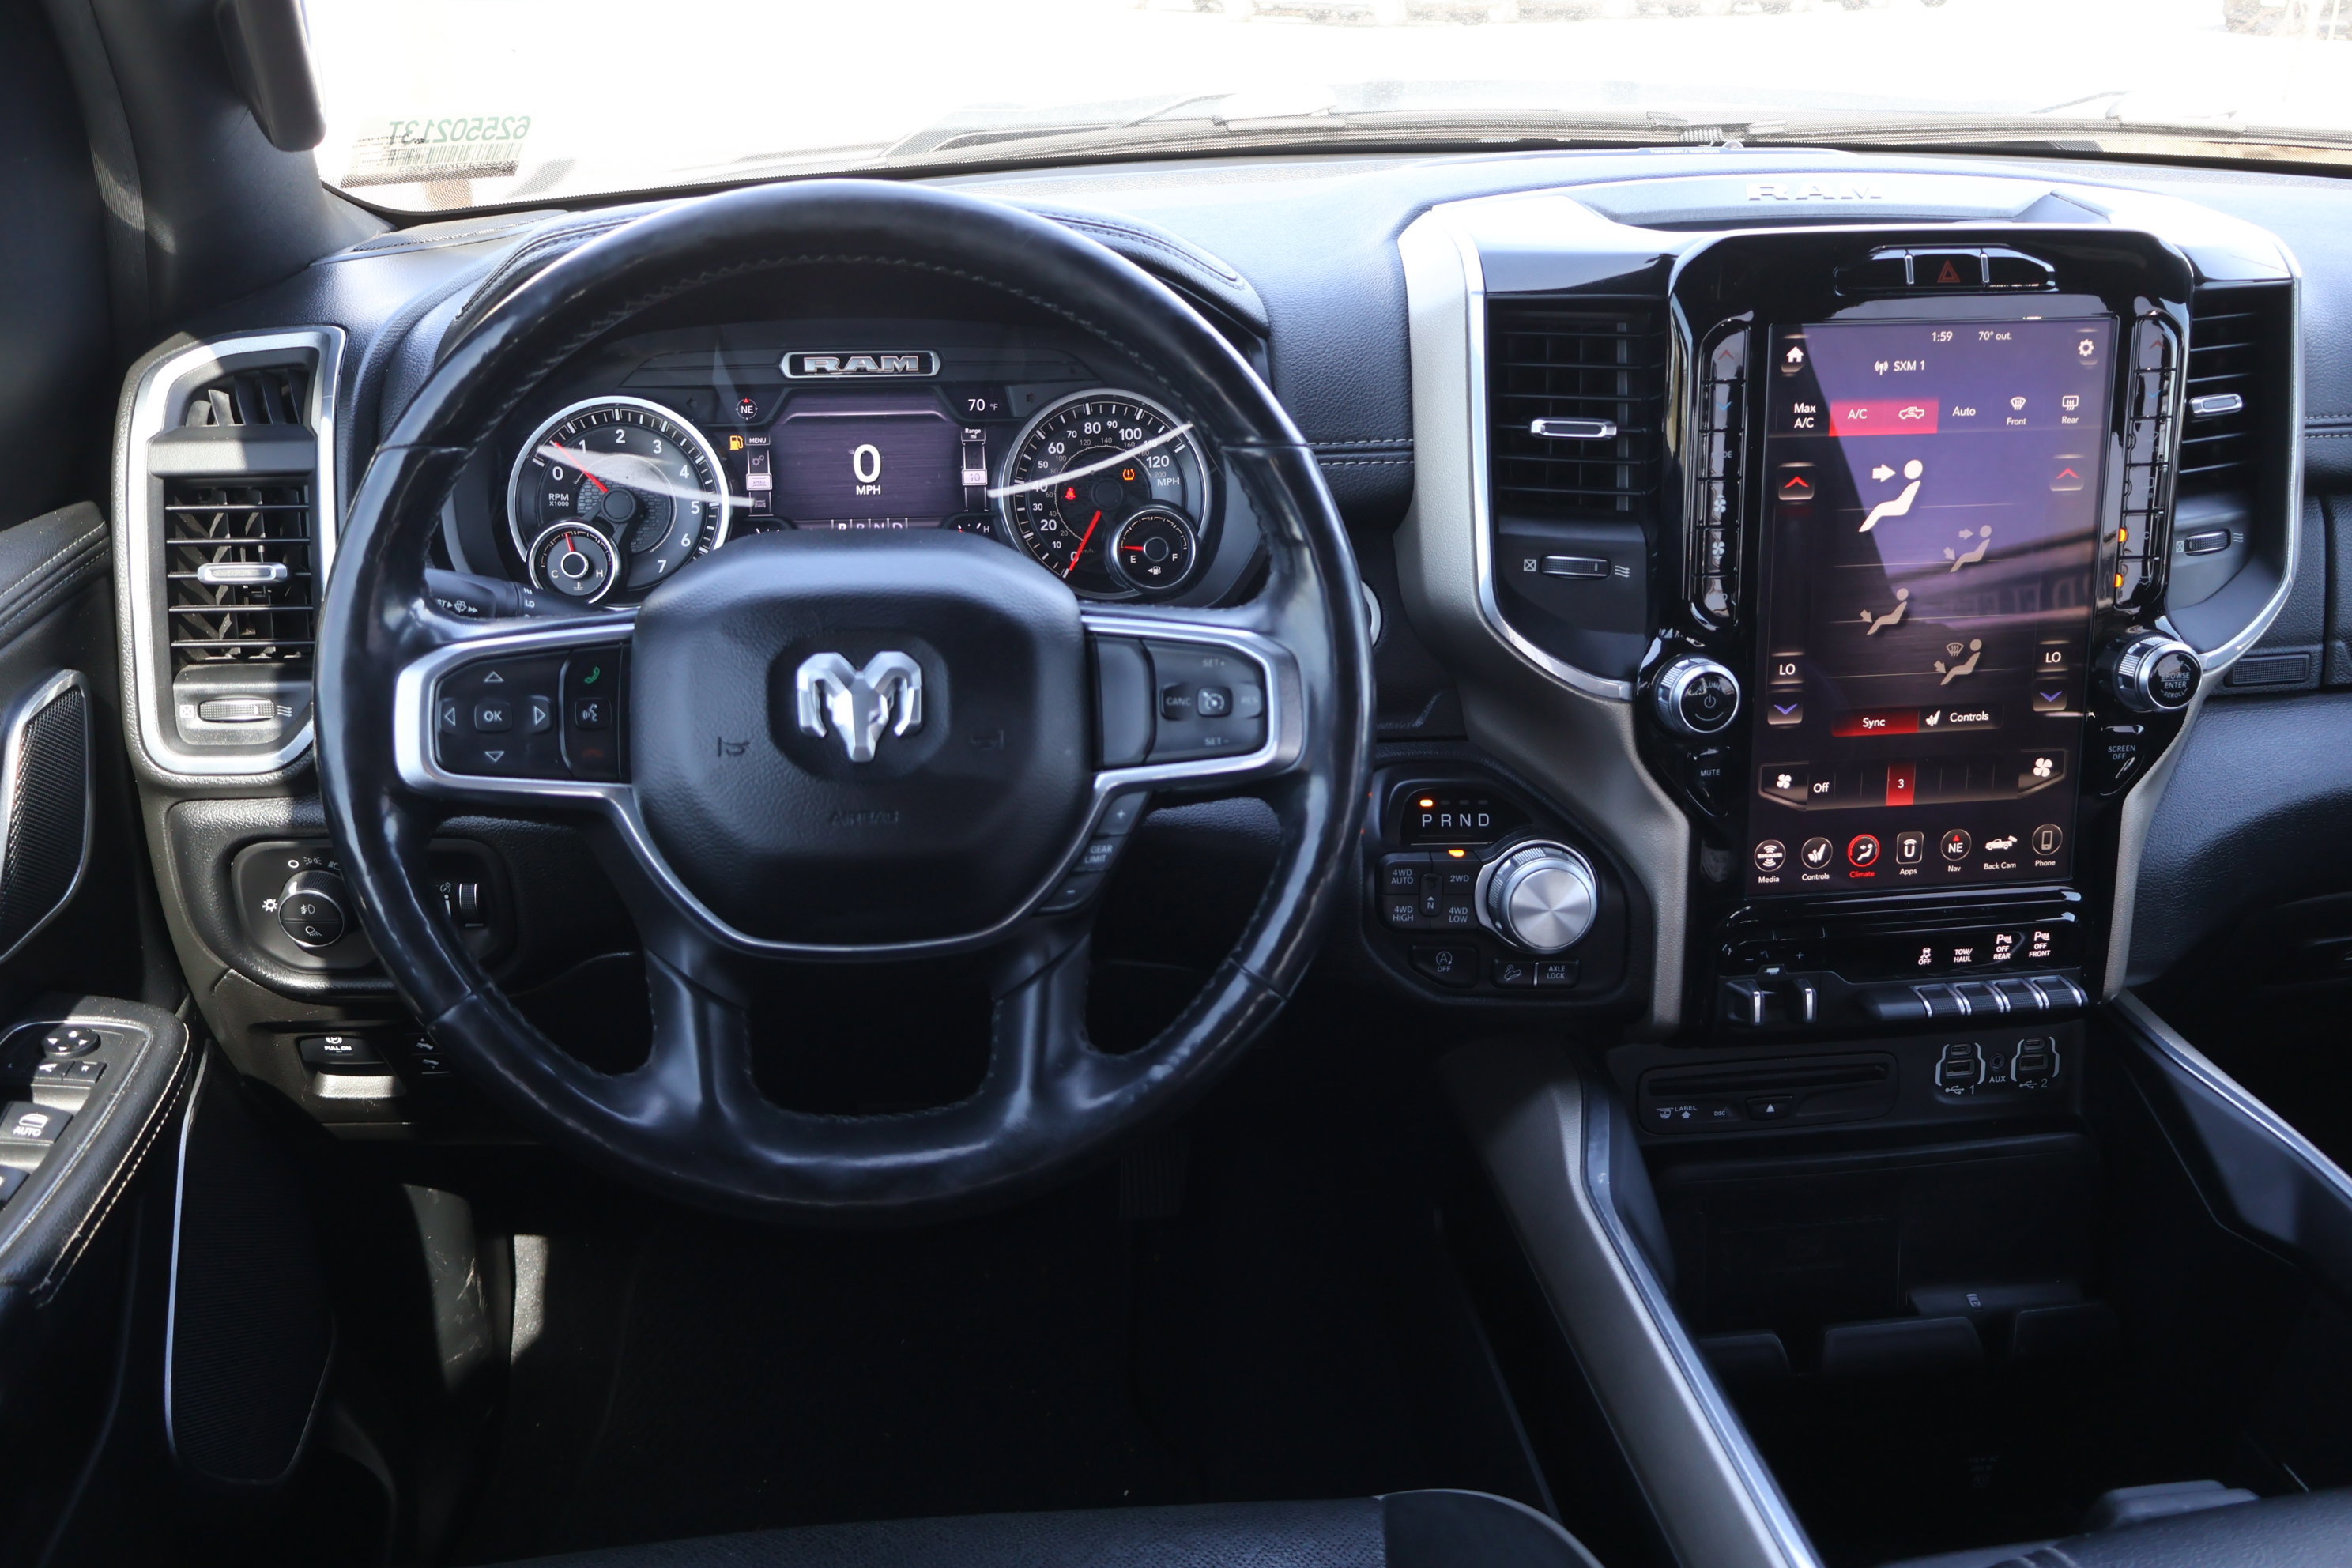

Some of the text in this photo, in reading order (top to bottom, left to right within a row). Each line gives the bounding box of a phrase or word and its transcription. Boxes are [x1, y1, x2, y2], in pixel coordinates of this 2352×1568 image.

[1746, 183, 1884, 201] RAM
[1931, 330, 1953, 342] 1:59
[803, 356, 919, 373] RAM
[1893, 360, 1925, 371] SXM 1
[741, 405, 753, 414] NE
[967, 398, 986, 412] 70
[1794, 403, 1816, 413] Max
[1848, 409, 1868, 420] A/C
[1952, 406, 1977, 416] Auto
[1106, 420, 1118, 429] 90
[1794, 417, 1815, 428] A/C
[2061, 416, 2079, 424] Rear
[1084, 422, 1102, 435] 80
[615, 429, 626, 444] 2
[1066, 430, 1077, 439] 70
[1118, 428, 1142, 441] 100
[579, 439, 586, 454] 1
[652, 439, 663, 454] 3
[1048, 442, 1065, 454] 60
[853, 443, 882, 484] 0
[1038, 460, 1049, 469] 50
[1146, 455, 1170, 469] 120
[552, 466, 564, 481] 0
[679, 465, 690, 479] 4
[1031, 481, 1048, 492] 40
[1157, 477, 1180, 487] MPH
[856, 484, 881, 495] MPH
[548, 493, 570, 502] RPM
[691, 500, 700, 514] 5
[1033, 503, 1043, 511] 30
[1040, 519, 1057, 531] 20
[680, 533, 691, 547] 6
[1052, 541, 1062, 549] 10
[1130, 555, 1136, 564] E
[1172, 553, 1178, 562] F
[657, 559, 667, 574] 7
[551, 569, 559, 579] C
[596, 569, 604, 578] H
[2045, 651, 2062, 664] LO
[1779, 663, 1796, 676] LO
[2162, 672, 2191, 681] BROWSE
[1166, 697, 1192, 706] CANC
[484, 711, 502, 722] OK
[1949, 710, 1989, 722] Controls
[1862, 717, 1886, 729] Sync
[2108, 744, 2136, 753] SCREEN
[1813, 782, 1830, 793] Off
[1898, 779, 1905, 789] 3
[1091, 844, 1113, 854] GEAR
[1948, 842, 1963, 854] NE
[1085, 854, 1106, 864] LIMIT
[2034, 859, 2056, 868] Phone
[1801, 873, 1830, 881] Controls
[1899, 867, 1917, 876] Apps
[1449, 874, 1470, 883] 2WD
[1758, 875, 1780, 884] Media
[1427, 901, 1434, 910] N
[1448, 906, 1468, 915] 4WD
[1392, 914, 1414, 922] HIGH
[1449, 914, 1468, 923] LOW
[2029, 949, 2051, 958] FRONT
[1988, 1075, 2007, 1084] AUX
[2041, 1078, 2049, 1089] 2
[1969, 1084, 1975, 1095] 1
[13, 1125, 42, 1137] AUTO
